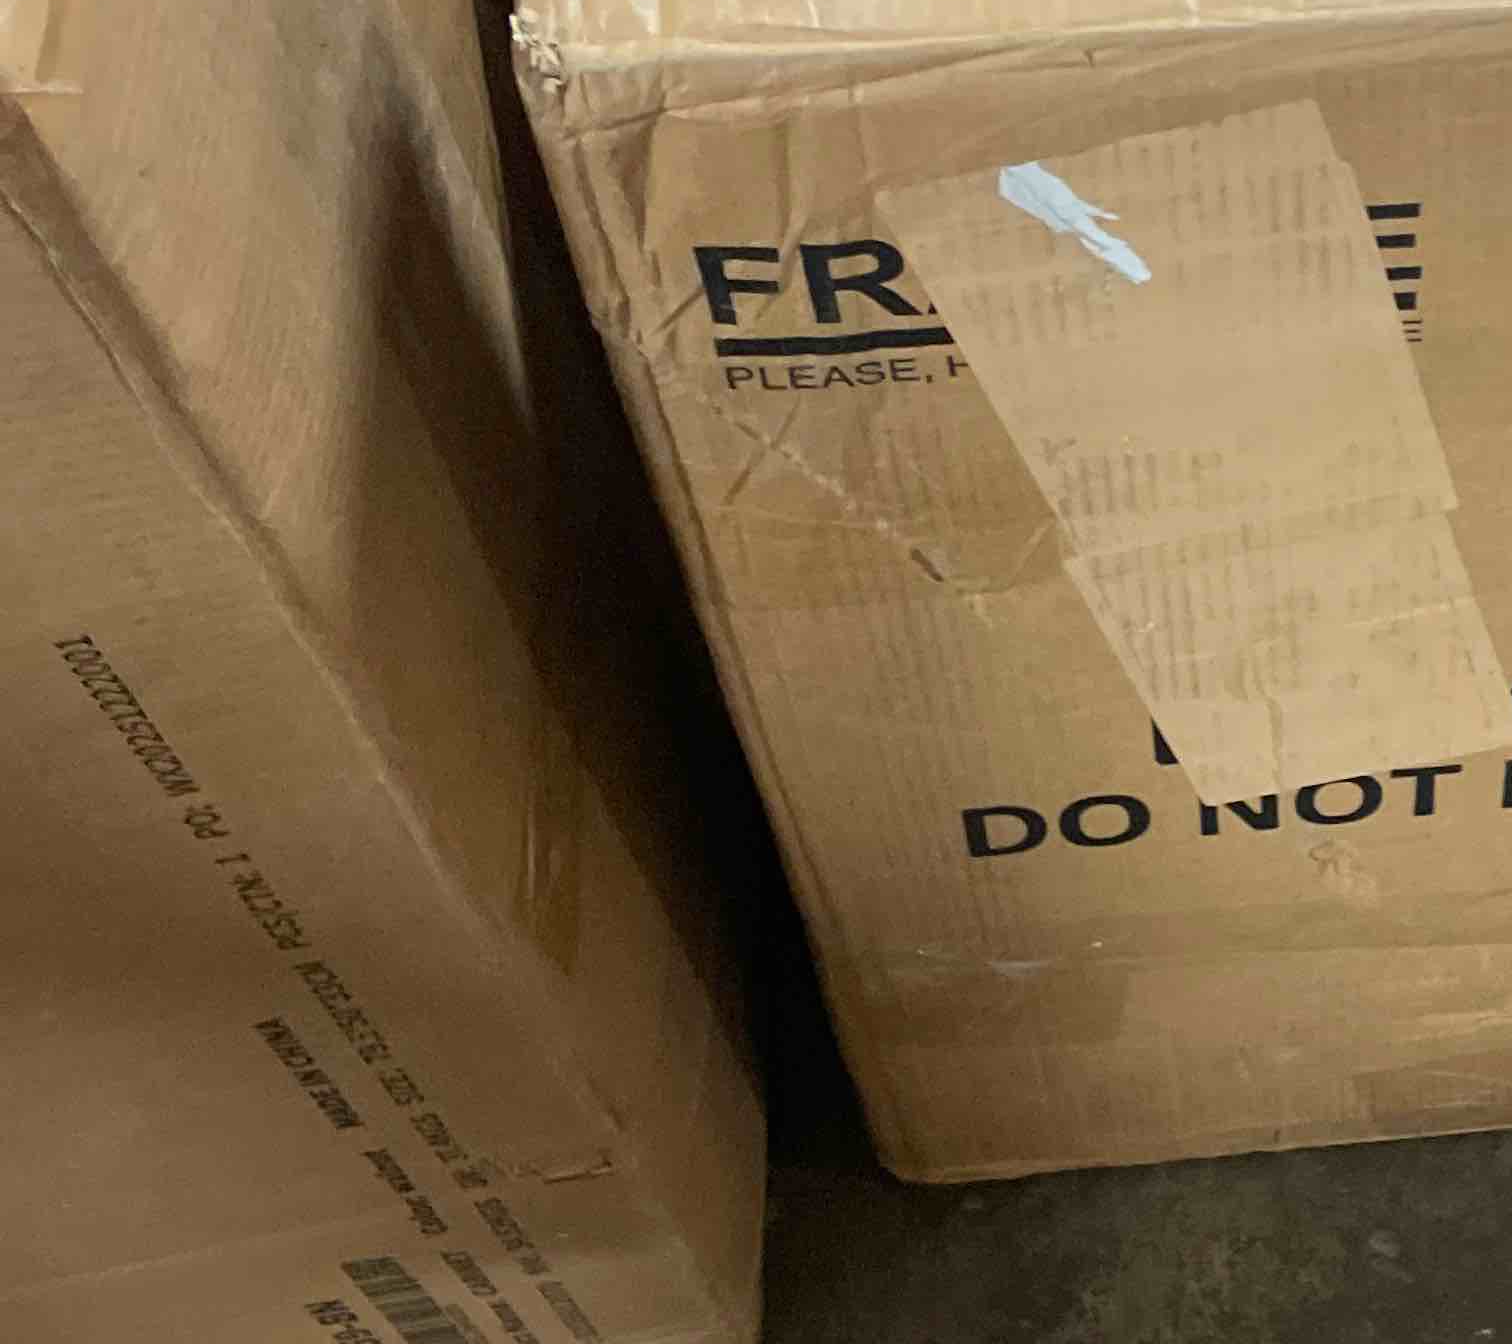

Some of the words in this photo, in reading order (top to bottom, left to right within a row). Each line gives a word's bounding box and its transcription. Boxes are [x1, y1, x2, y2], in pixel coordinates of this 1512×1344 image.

[726, 356, 935, 391] PLEASE,
[962, 794, 1151, 858] DO
[1200, 763, 1463, 836] NOT
[252, 1016, 317, 1068] CHINA
